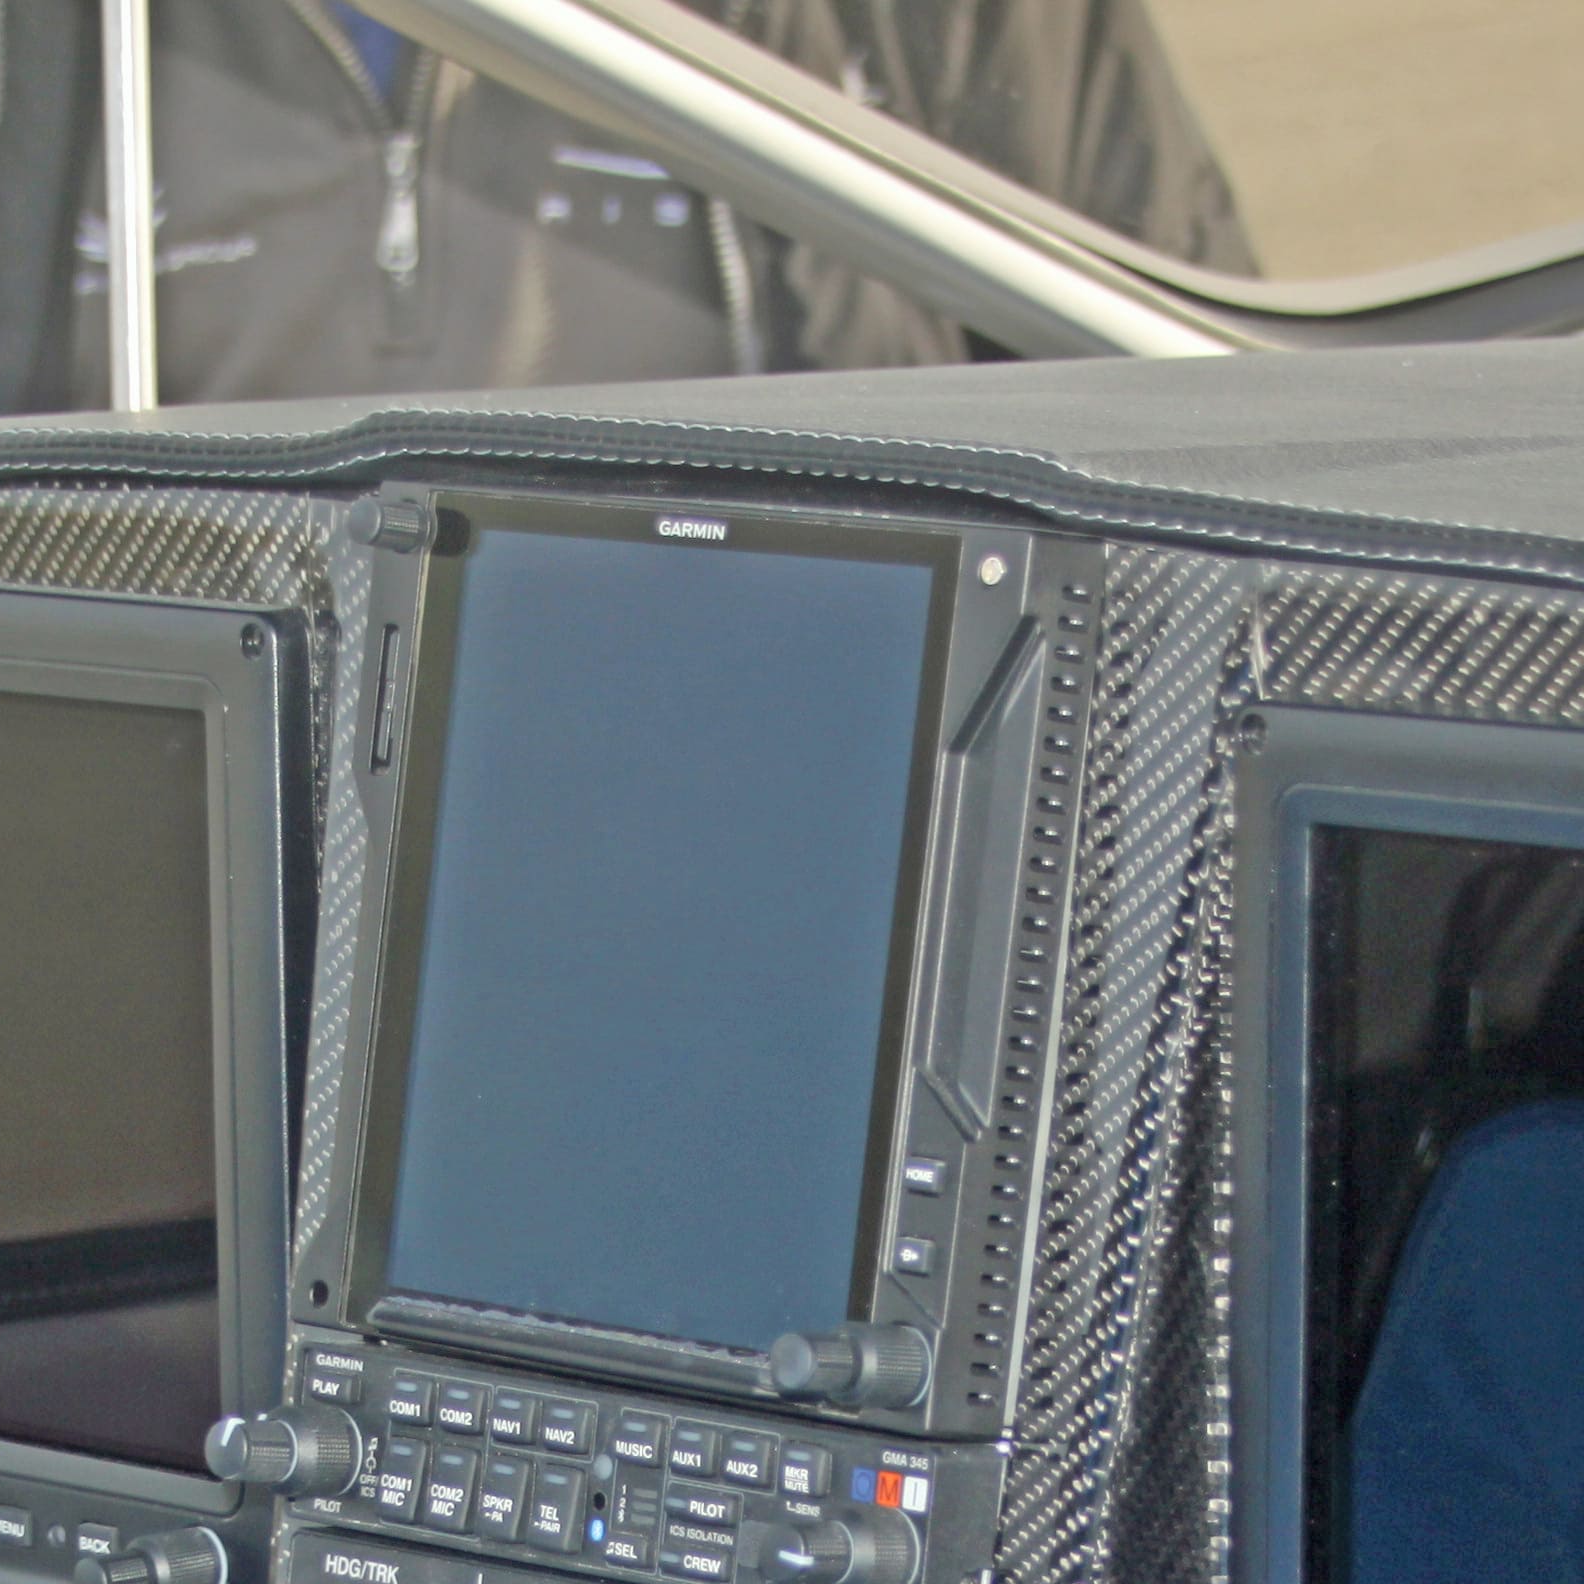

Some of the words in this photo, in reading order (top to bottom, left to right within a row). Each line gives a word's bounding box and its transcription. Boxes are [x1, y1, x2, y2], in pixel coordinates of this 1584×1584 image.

[658, 520, 726, 541] GARMIN
[905, 1167, 934, 1183] HOME
[316, 1353, 364, 1372] GARMIN
[312, 1379, 340, 1396] PLAY
[389, 1400, 421, 1417] COM1
[440, 1408, 473, 1426] COM2
[493, 1418, 521, 1435] NAV1
[545, 1427, 575, 1445] NAV2
[616, 1440, 653, 1459] MUSIC
[672, 1450, 702, 1467] AUX1
[882, 1451, 907, 1468] GMA
[909, 1454, 929, 1471] 345
[726, 1460, 758, 1478] AUX2
[784, 1466, 809, 1481] MKR
[380, 1473, 413, 1491] COM1
[784, 1480, 809, 1494] MUTE
[381, 1490, 406, 1507] MIC
[430, 1483, 464, 1502] COM2
[313, 1498, 342, 1513] PILOT
[431, 1500, 455, 1516] MIC
[482, 1494, 513, 1513] SPKR
[689, 1500, 726, 1519] PILOT
[539, 1504, 559, 1521] TEL
[539, 1520, 561, 1534] PAIR
[669, 1524, 686, 1539] ICS
[686, 1526, 734, 1546] ISOLATION
[615, 1542, 638, 1559] SEL
[683, 1555, 722, 1574] CREW
